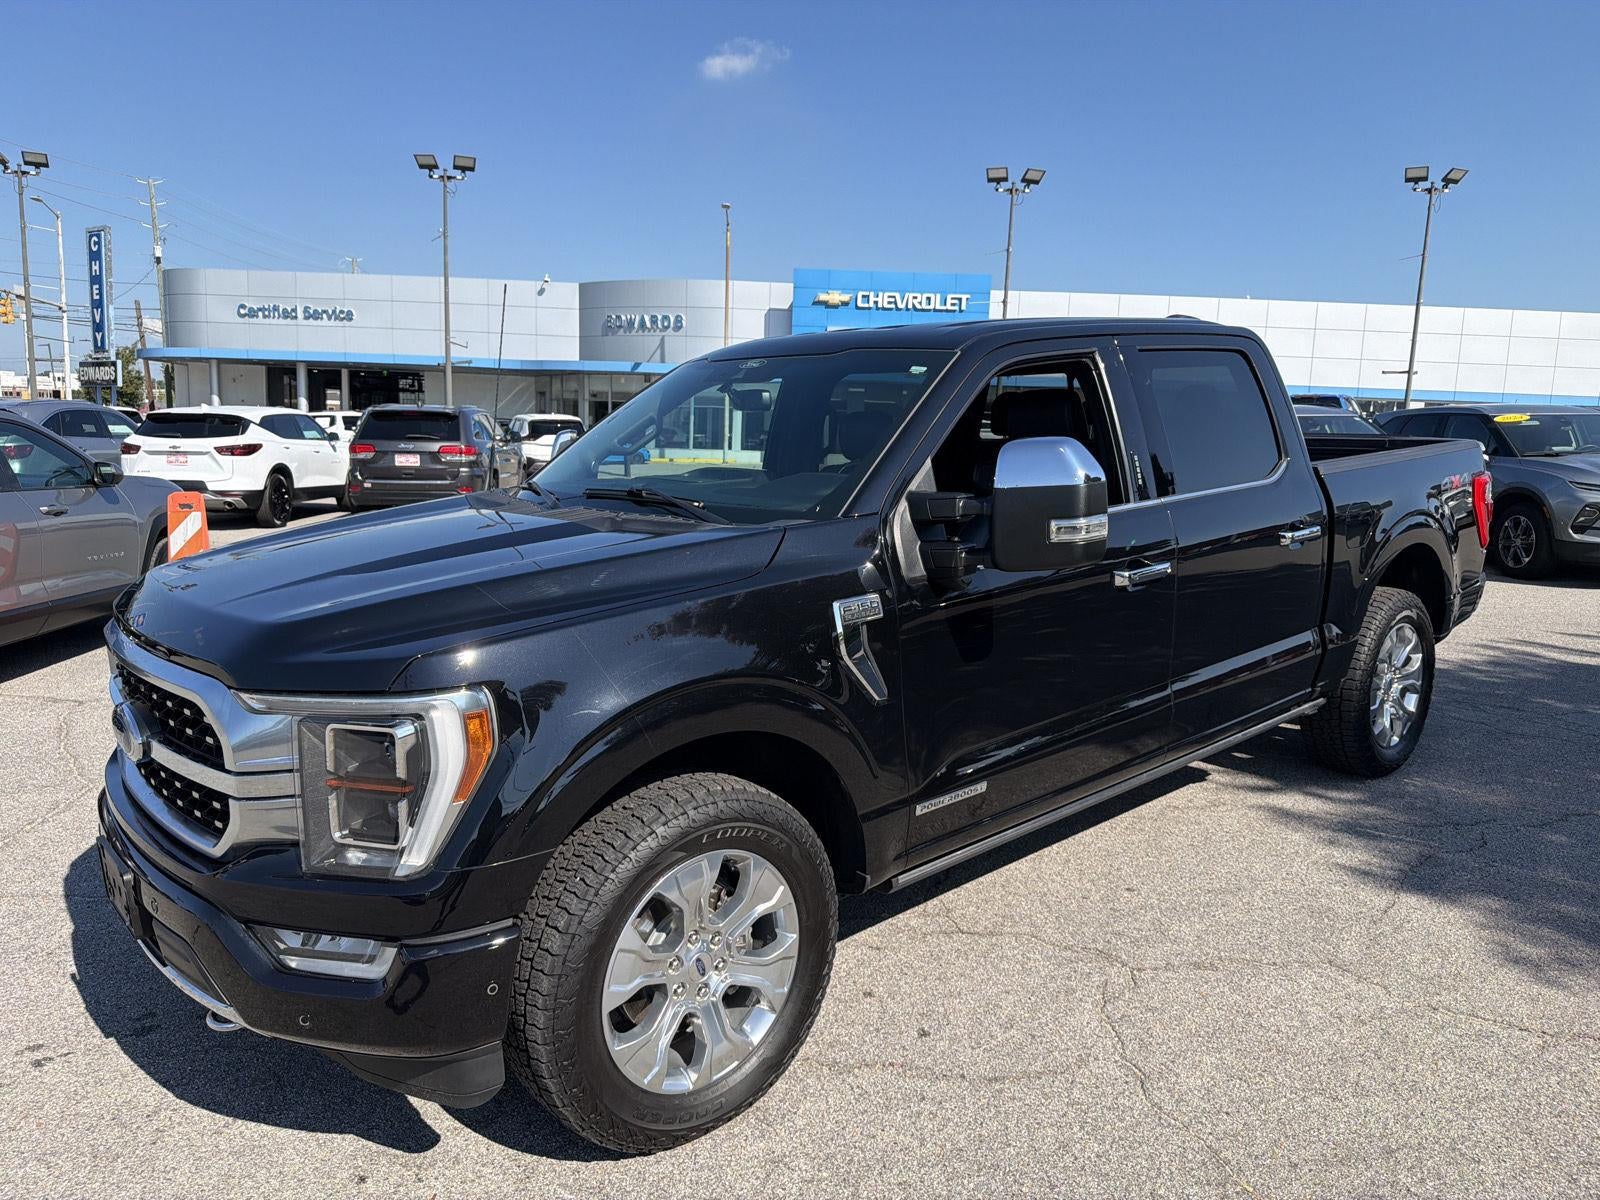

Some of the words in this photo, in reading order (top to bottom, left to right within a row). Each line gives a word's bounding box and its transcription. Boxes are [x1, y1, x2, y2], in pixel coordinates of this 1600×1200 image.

[90, 236, 103, 347] CHEVY
[856, 290, 971, 311] CHEVROLET
[236, 303, 298, 320] Certified
[302, 305, 354, 322] Service
[606, 314, 684, 332] EDWARDS
[79, 365, 116, 381] EDWARDS
[920, 783, 986, 812] POWERBOOST
[702, 827, 785, 849] COOPER
